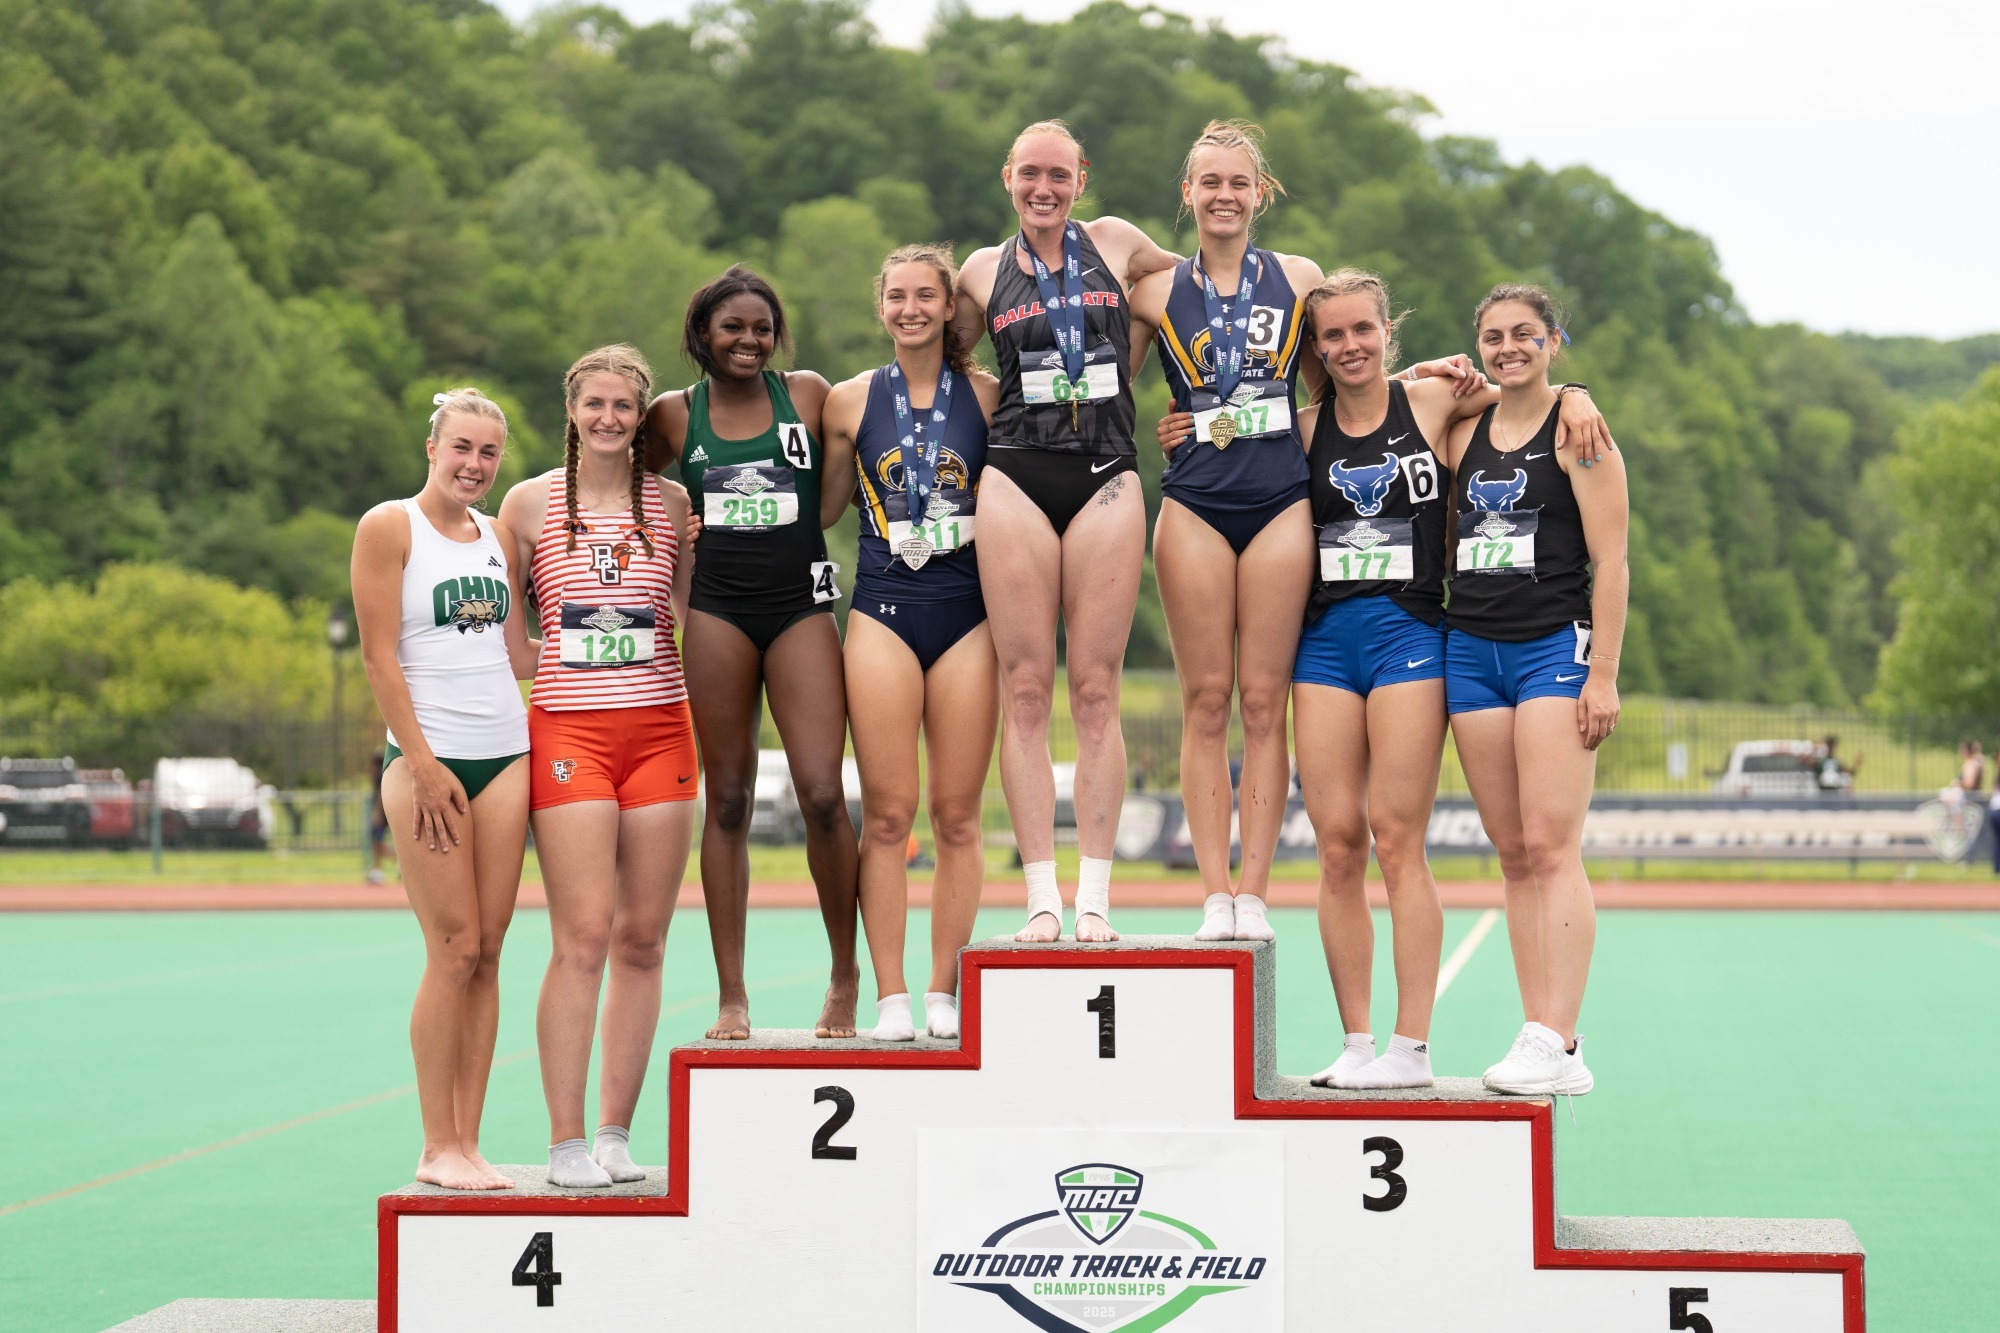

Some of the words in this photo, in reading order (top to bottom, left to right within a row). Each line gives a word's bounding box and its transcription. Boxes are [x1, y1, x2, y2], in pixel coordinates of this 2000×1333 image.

[993, 301, 1046, 334] BALL
[1247, 308, 1275, 346] 3
[1052, 372, 1090, 401] 65
[1211, 427, 1235, 436] MAC
[688, 454, 709, 464] adidas
[787, 427, 807, 466] 4
[1410, 457, 1433, 499] 6
[723, 498, 779, 525] 259
[902, 549, 930, 557] MAC
[1338, 551, 1392, 581] 177
[1470, 541, 1514, 569] 172
[815, 564, 835, 598] 4
[432, 575, 511, 627] OHIO
[581, 634, 635, 662] 120
[1087, 985, 1116, 1059] 1
[811, 1085, 857, 1161] 2
[1088, 1173, 1111, 1181] 1946
[1362, 1136, 1408, 1212] 3
[1062, 1189, 1138, 1209] MAC
[511, 1232, 562, 1307] 4
[932, 1253, 1064, 1278] OUTDOOR
[1069, 1255, 1163, 1278] TRACK
[1161, 1256, 1183, 1279] &
[1187, 1256, 1267, 1280] FIELD
[1033, 1282, 1166, 1296] CHAMPIONSHIPS
[1083, 1306, 1116, 1318] 2025
[1669, 1287, 1714, 1333] 5
